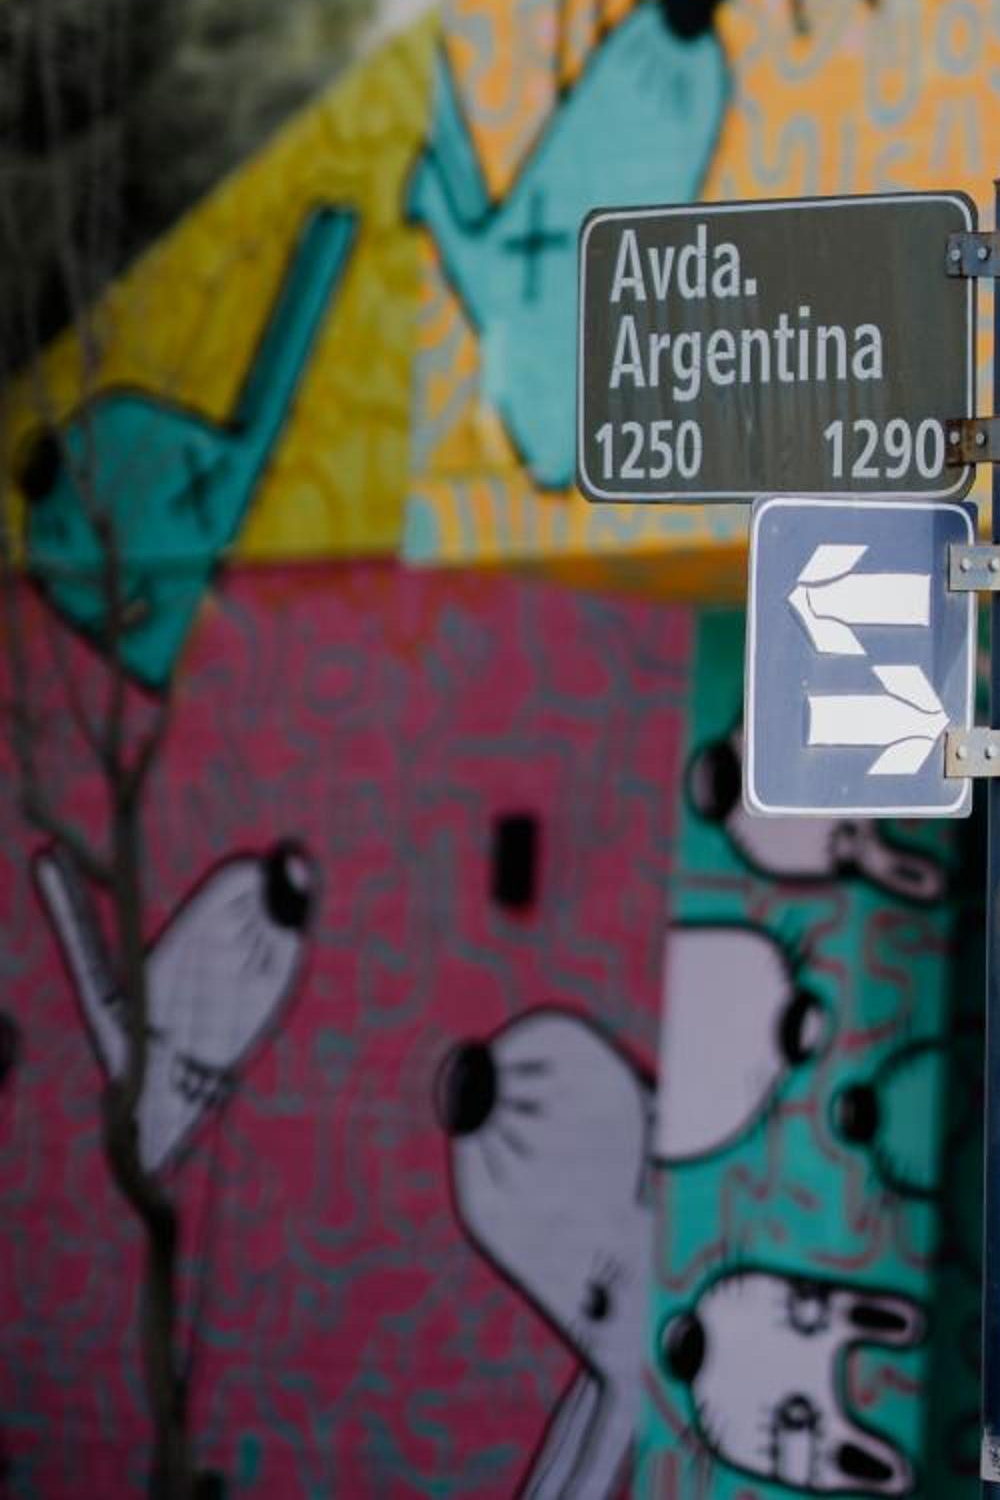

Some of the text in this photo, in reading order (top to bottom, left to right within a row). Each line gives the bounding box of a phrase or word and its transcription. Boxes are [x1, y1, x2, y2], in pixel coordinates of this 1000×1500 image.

[609, 223, 757, 302] Avda.
[609, 305, 882, 402] Argentina
[595, 417, 945, 479] 1250 1290
